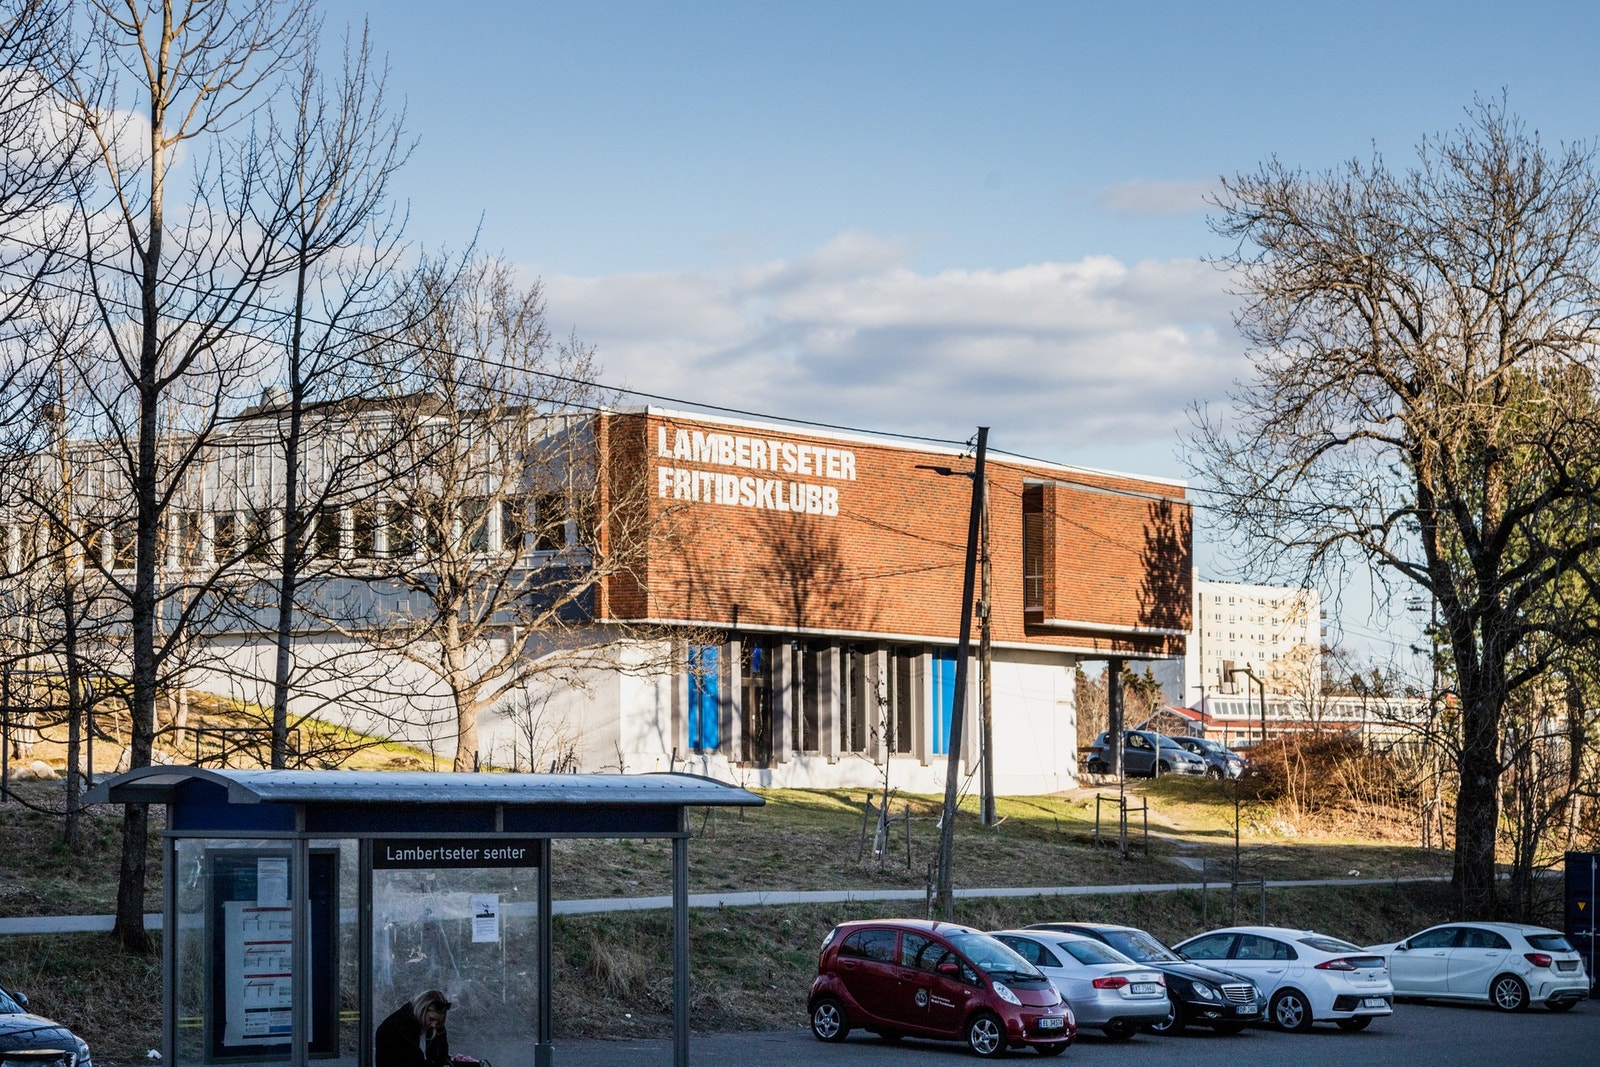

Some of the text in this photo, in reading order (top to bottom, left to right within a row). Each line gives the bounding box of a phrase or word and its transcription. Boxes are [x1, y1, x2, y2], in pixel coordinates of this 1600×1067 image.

[658, 426, 856, 480] LAMBERTSETER
[658, 466, 839, 517] FRITIDSKLUBB
[387, 846, 526, 861] Lambertseter senter
